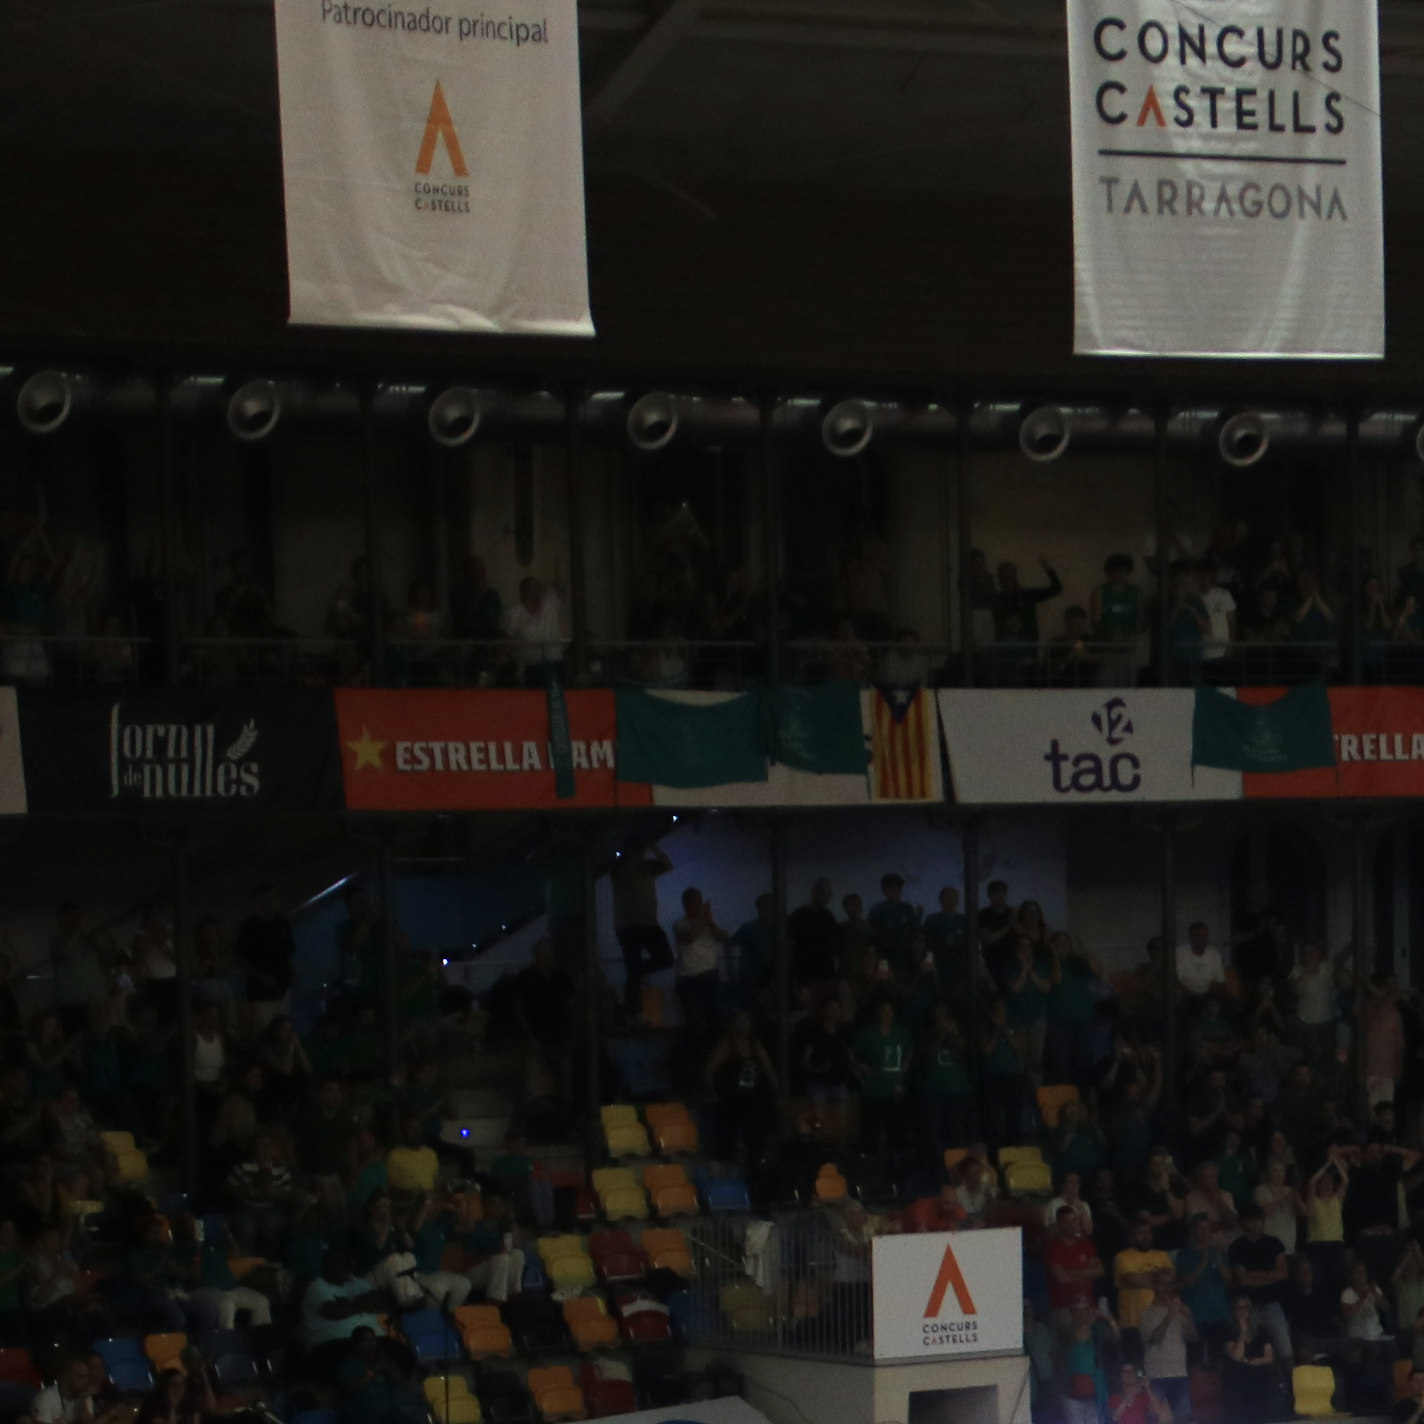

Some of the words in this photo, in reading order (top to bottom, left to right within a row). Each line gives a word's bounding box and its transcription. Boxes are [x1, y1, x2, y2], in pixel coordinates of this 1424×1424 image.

[322, 0, 452, 35] Patrocinador
[458, 13, 549, 47] principal
[1093, 17, 1346, 73] CONCURS
[1095, 81, 1347, 136] CASTELLS
[414, 182, 470, 197] CONCURS
[1100, 175, 1349, 222] TARRAGONA
[414, 199, 471, 213] CASTELLS
[395, 740, 543, 772] ESTRELLA
[1043, 738, 1142, 794] tac
[123, 763, 142, 787] de
[922, 1320, 978, 1335] CONCURS
[922, 1332, 979, 1347] CASTELLS
